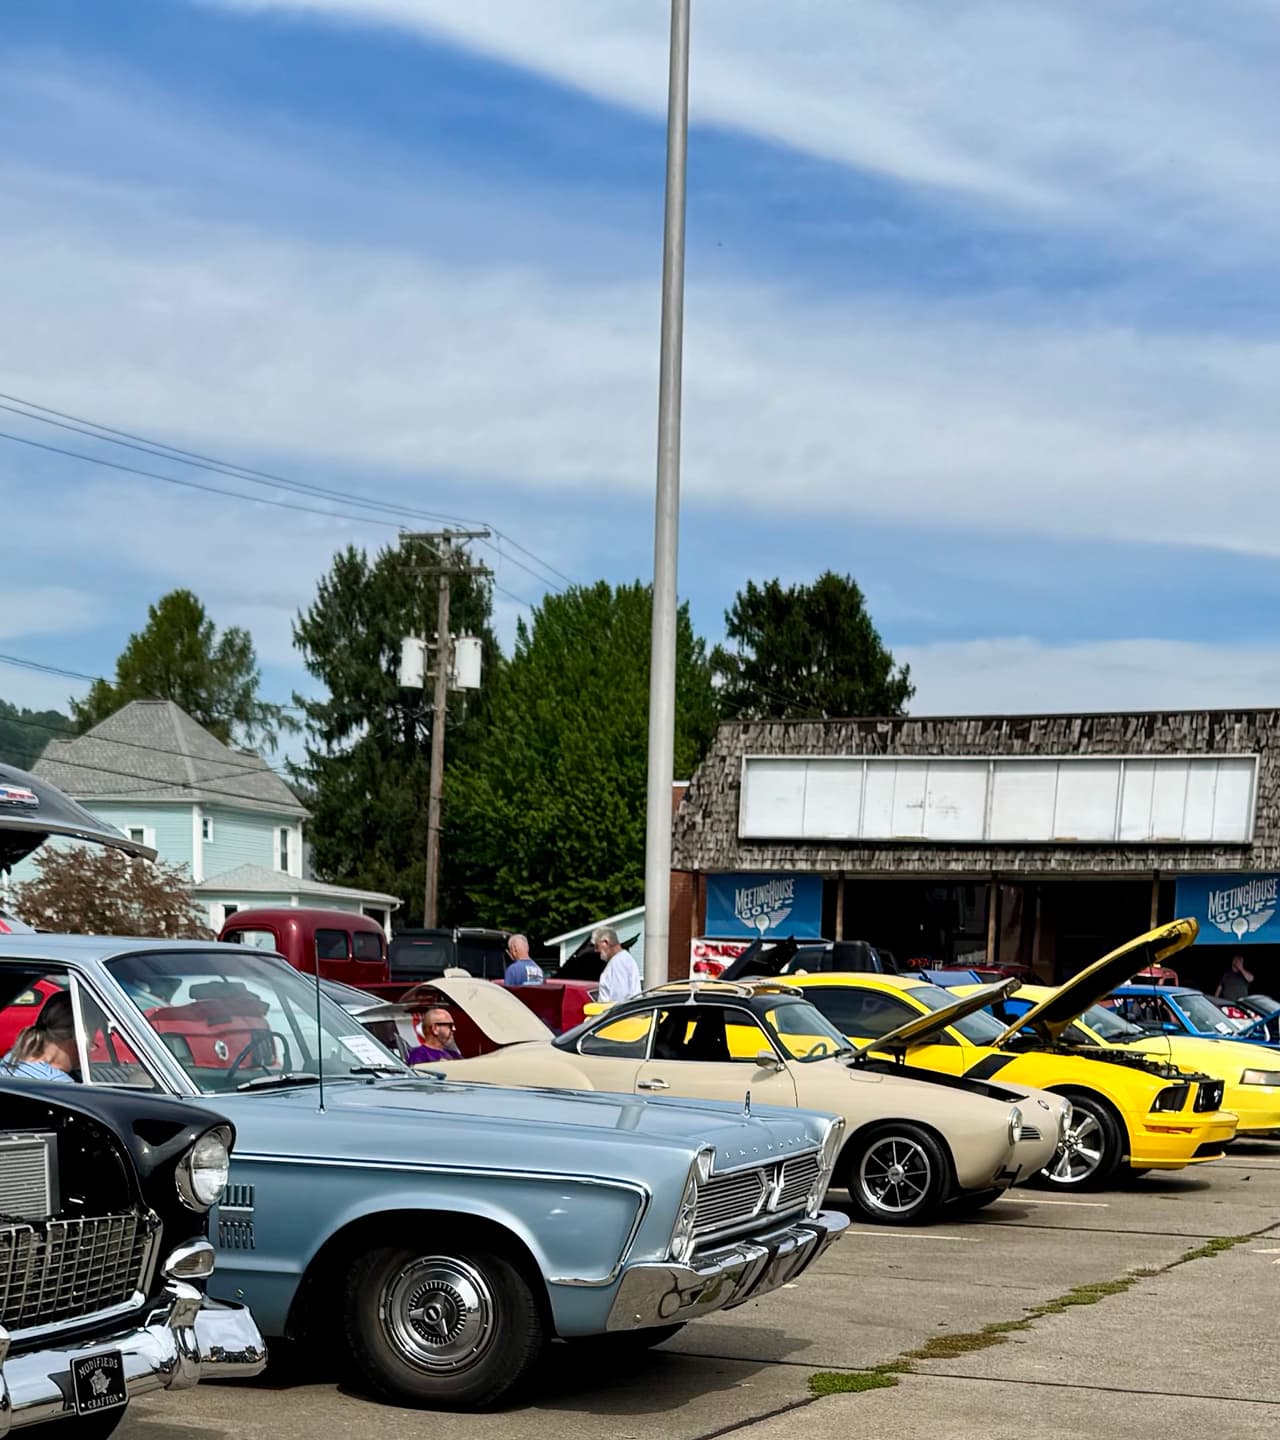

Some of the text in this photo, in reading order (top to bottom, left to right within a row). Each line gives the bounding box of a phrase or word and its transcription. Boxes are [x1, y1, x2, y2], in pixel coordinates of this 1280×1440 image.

[735, 879, 794, 916] MEETINGHOUSE
[1208, 878, 1279, 919] MEETINGHOUSE
[741, 900, 783, 919] GOLF
[1216, 901, 1265, 923] GOLF
[79, 1357, 118, 1378] MODIFIEDS
